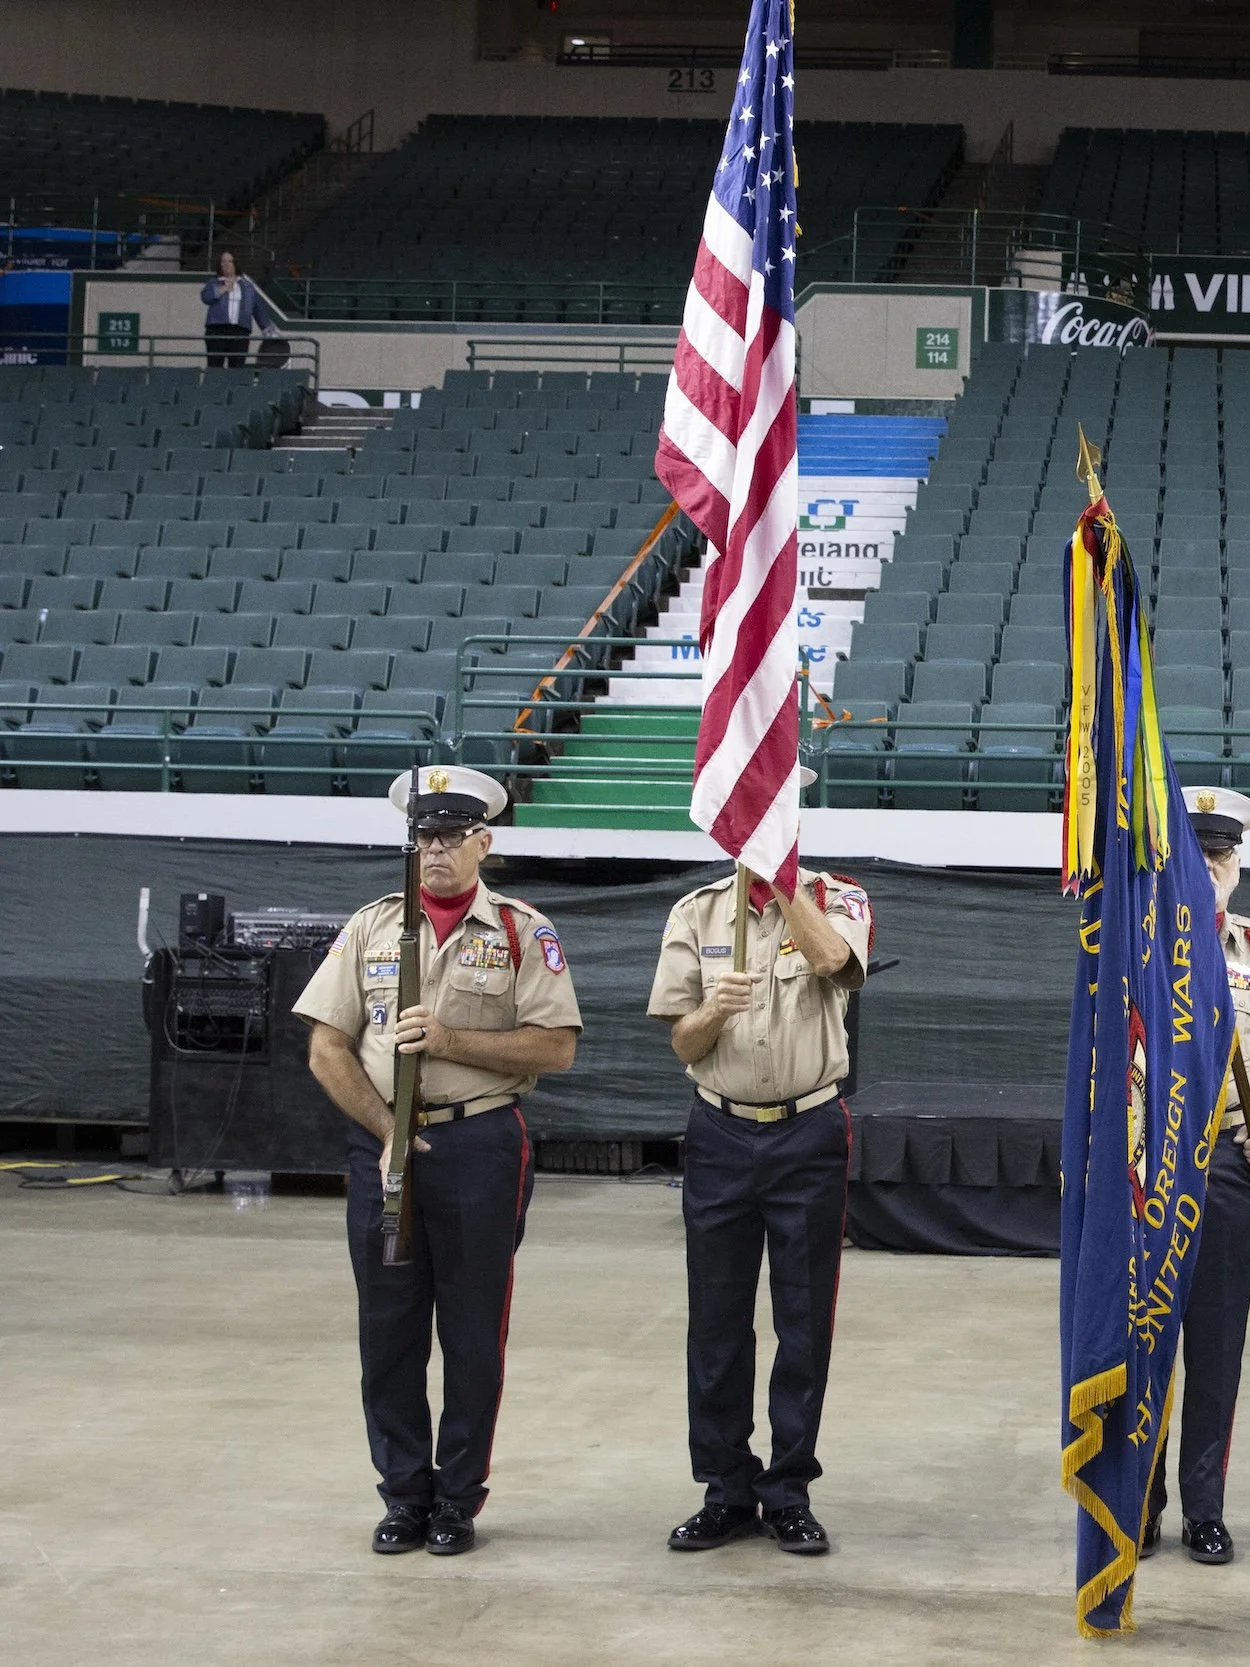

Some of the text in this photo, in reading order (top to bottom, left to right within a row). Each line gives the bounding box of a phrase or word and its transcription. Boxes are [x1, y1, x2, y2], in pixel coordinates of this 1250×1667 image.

[668, 69, 715, 88] 213
[109, 320, 131, 331] 213
[926, 333, 950, 346] 214
[927, 351, 949, 364] 114
[1081, 746, 1092, 806] 2005
[1171, 902, 1194, 1044] WARS
